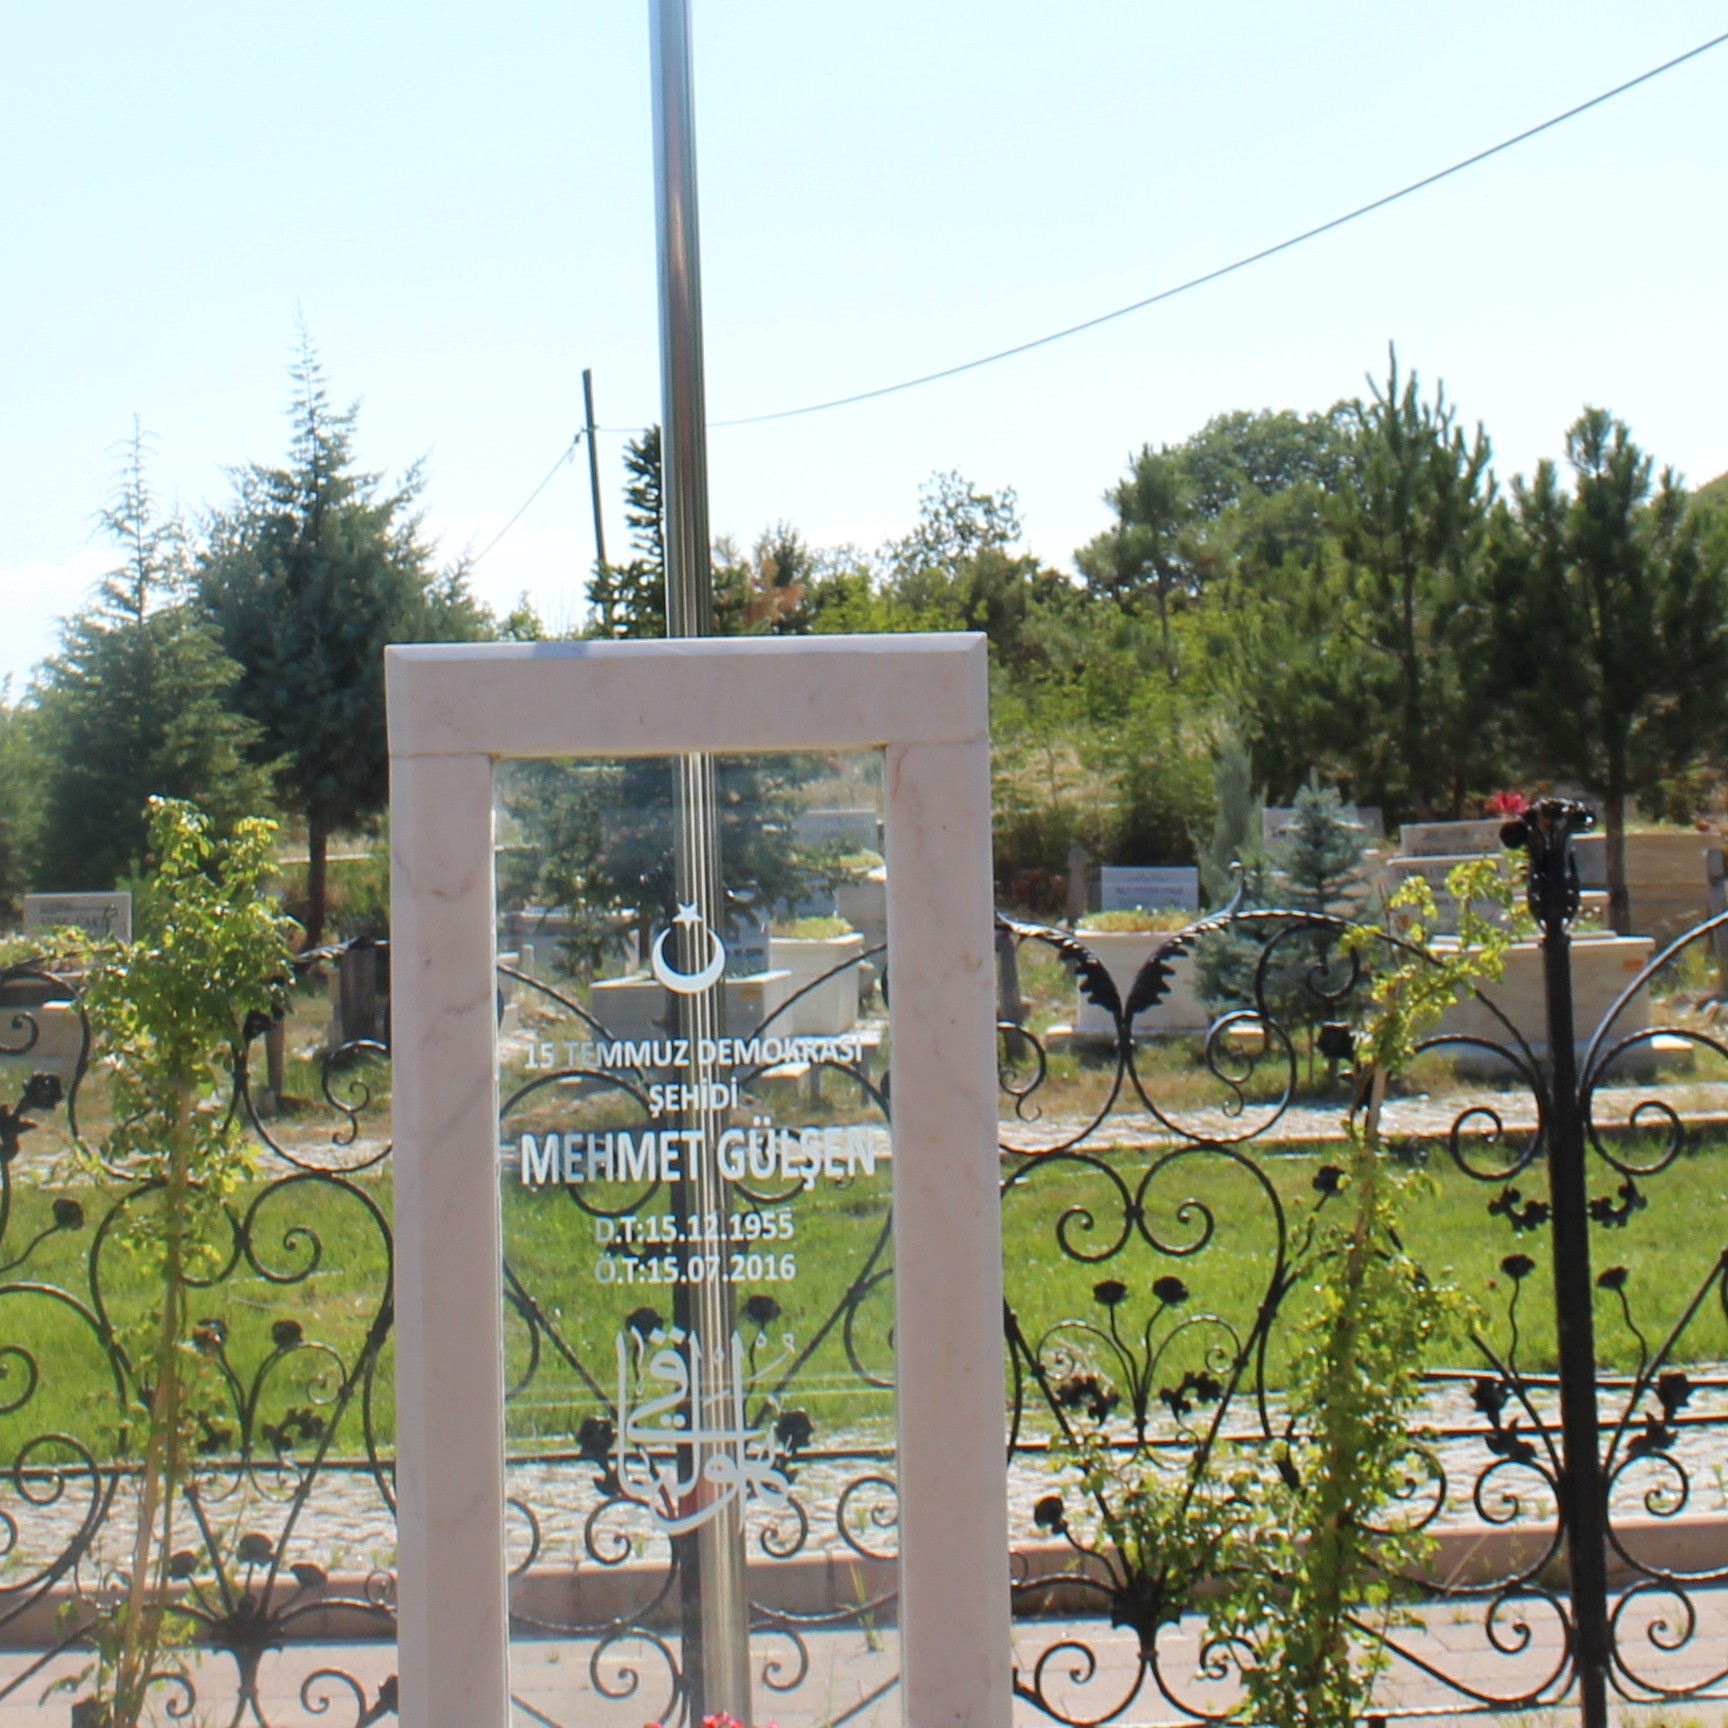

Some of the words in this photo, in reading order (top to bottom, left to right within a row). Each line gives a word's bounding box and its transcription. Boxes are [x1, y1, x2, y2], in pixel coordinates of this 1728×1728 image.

[524, 1041, 556, 1070] 15
[565, 1038, 690, 1069] TEMMUZ
[697, 1030, 864, 1066] DEMOKRASİ
[648, 1076, 740, 1117] ŞEHİDİ
[521, 1129, 705, 1185] MEHMET
[716, 1116, 876, 1191] GÜLŞEN
[594, 1212, 795, 1245] D.T:15.12.1955
[594, 1251, 797, 1285] Ö.T:15.07.2016
